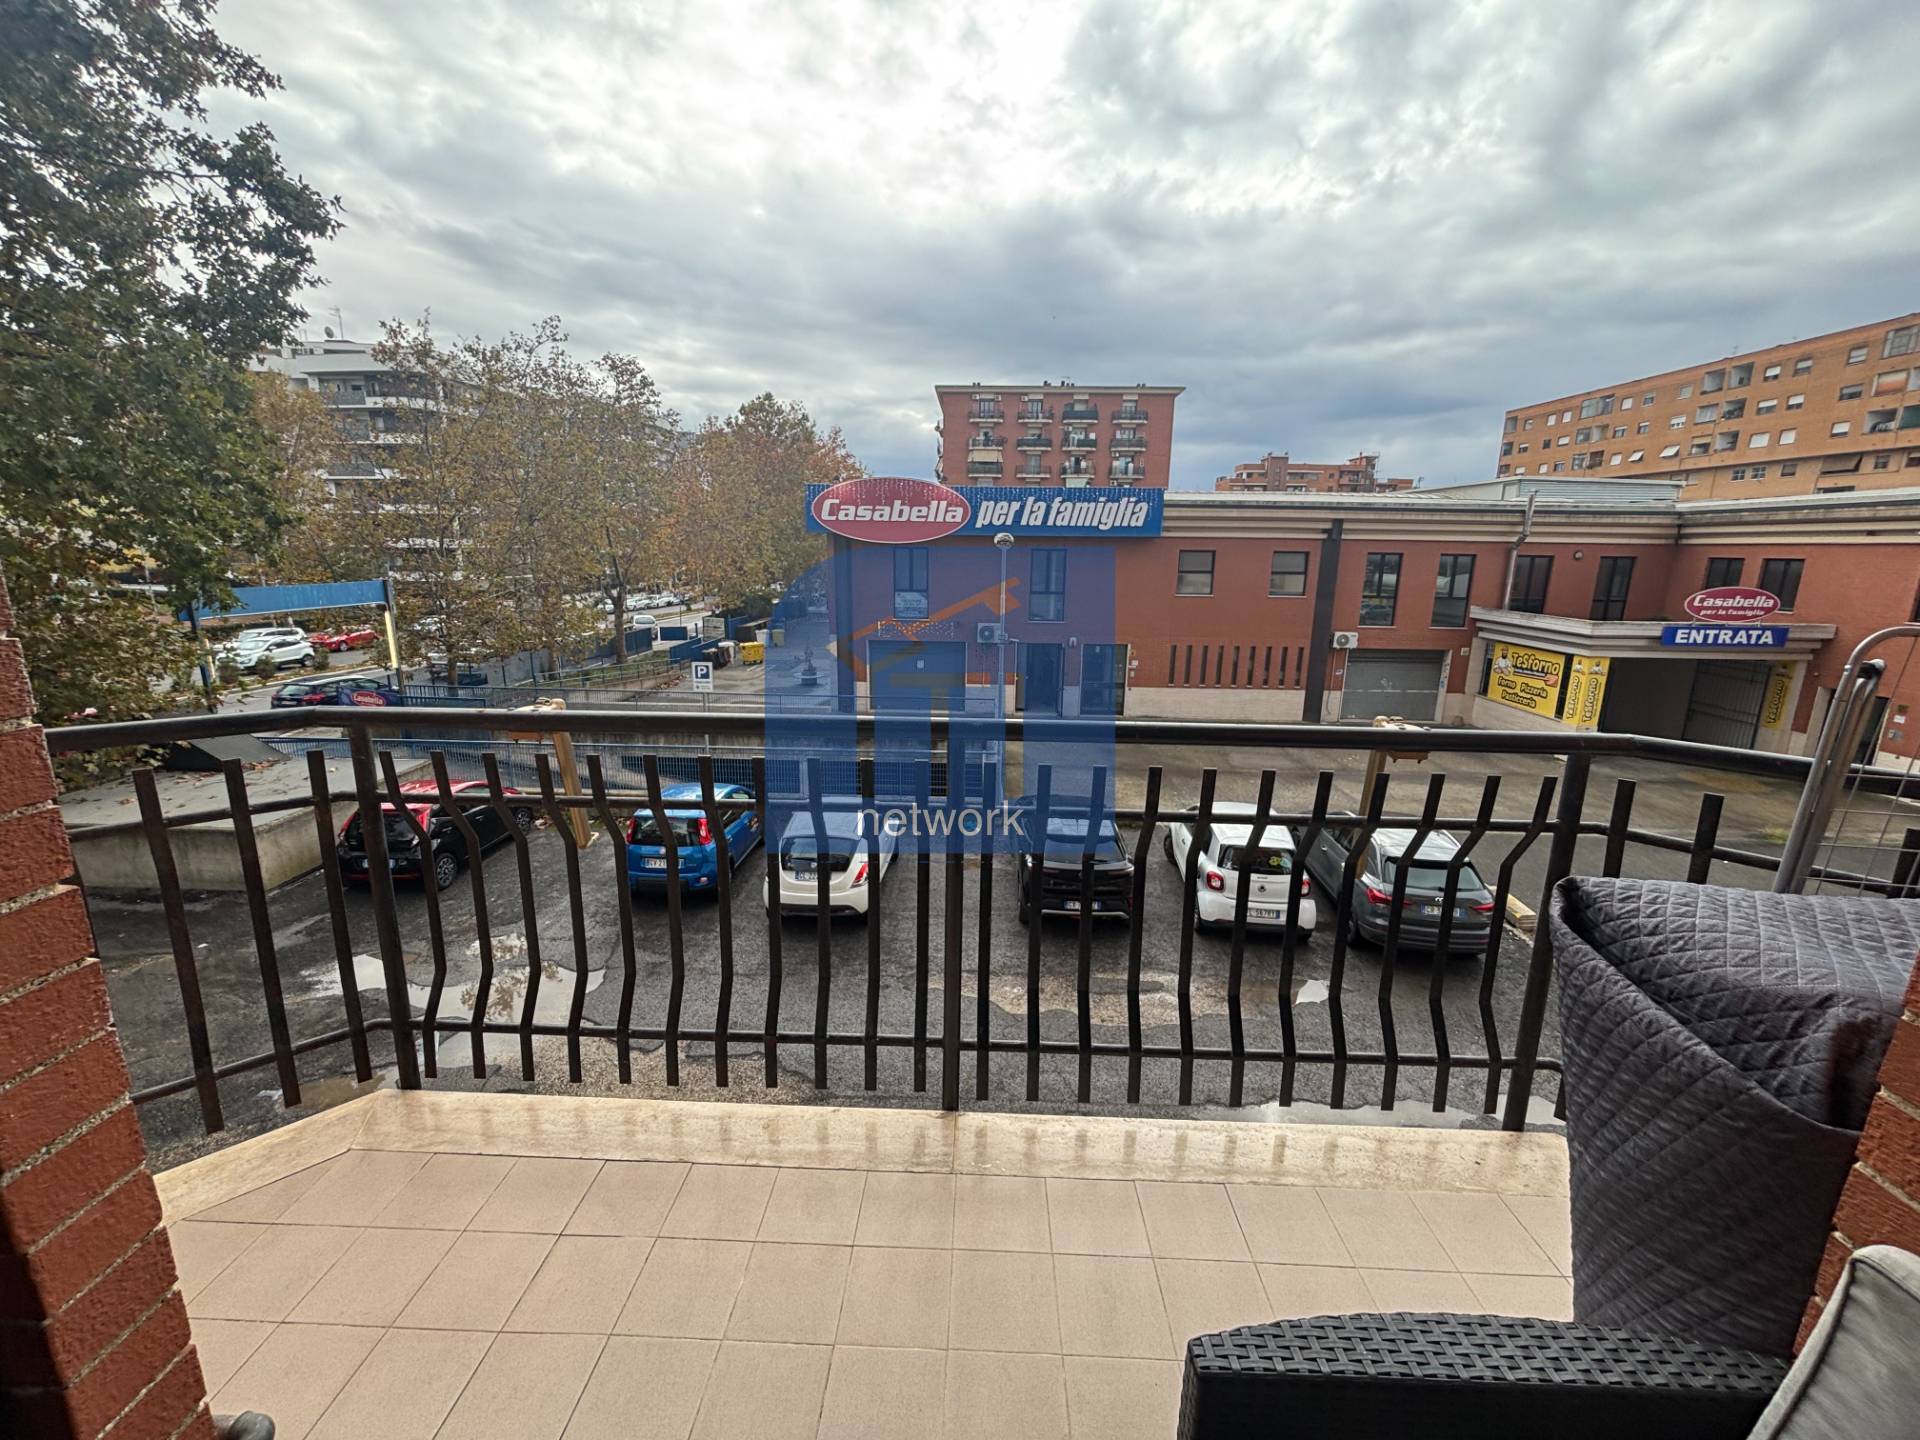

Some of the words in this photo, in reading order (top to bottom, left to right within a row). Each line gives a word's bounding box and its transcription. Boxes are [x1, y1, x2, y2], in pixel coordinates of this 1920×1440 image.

[820, 498, 964, 523] Casabella
[975, 498, 1022, 528] per
[1022, 496, 1047, 526] la
[1050, 496, 1148, 530] famiglia
[1693, 594, 1774, 608] Casabella
[1727, 609, 1765, 617] famiglia
[1674, 628, 1774, 645] ENTRATA
[697, 666, 707, 678] P
[1498, 676, 1516, 689] Forno
[1520, 682, 1548, 699] Pizzeria
[1501, 689, 1536, 708] Pasticceria
